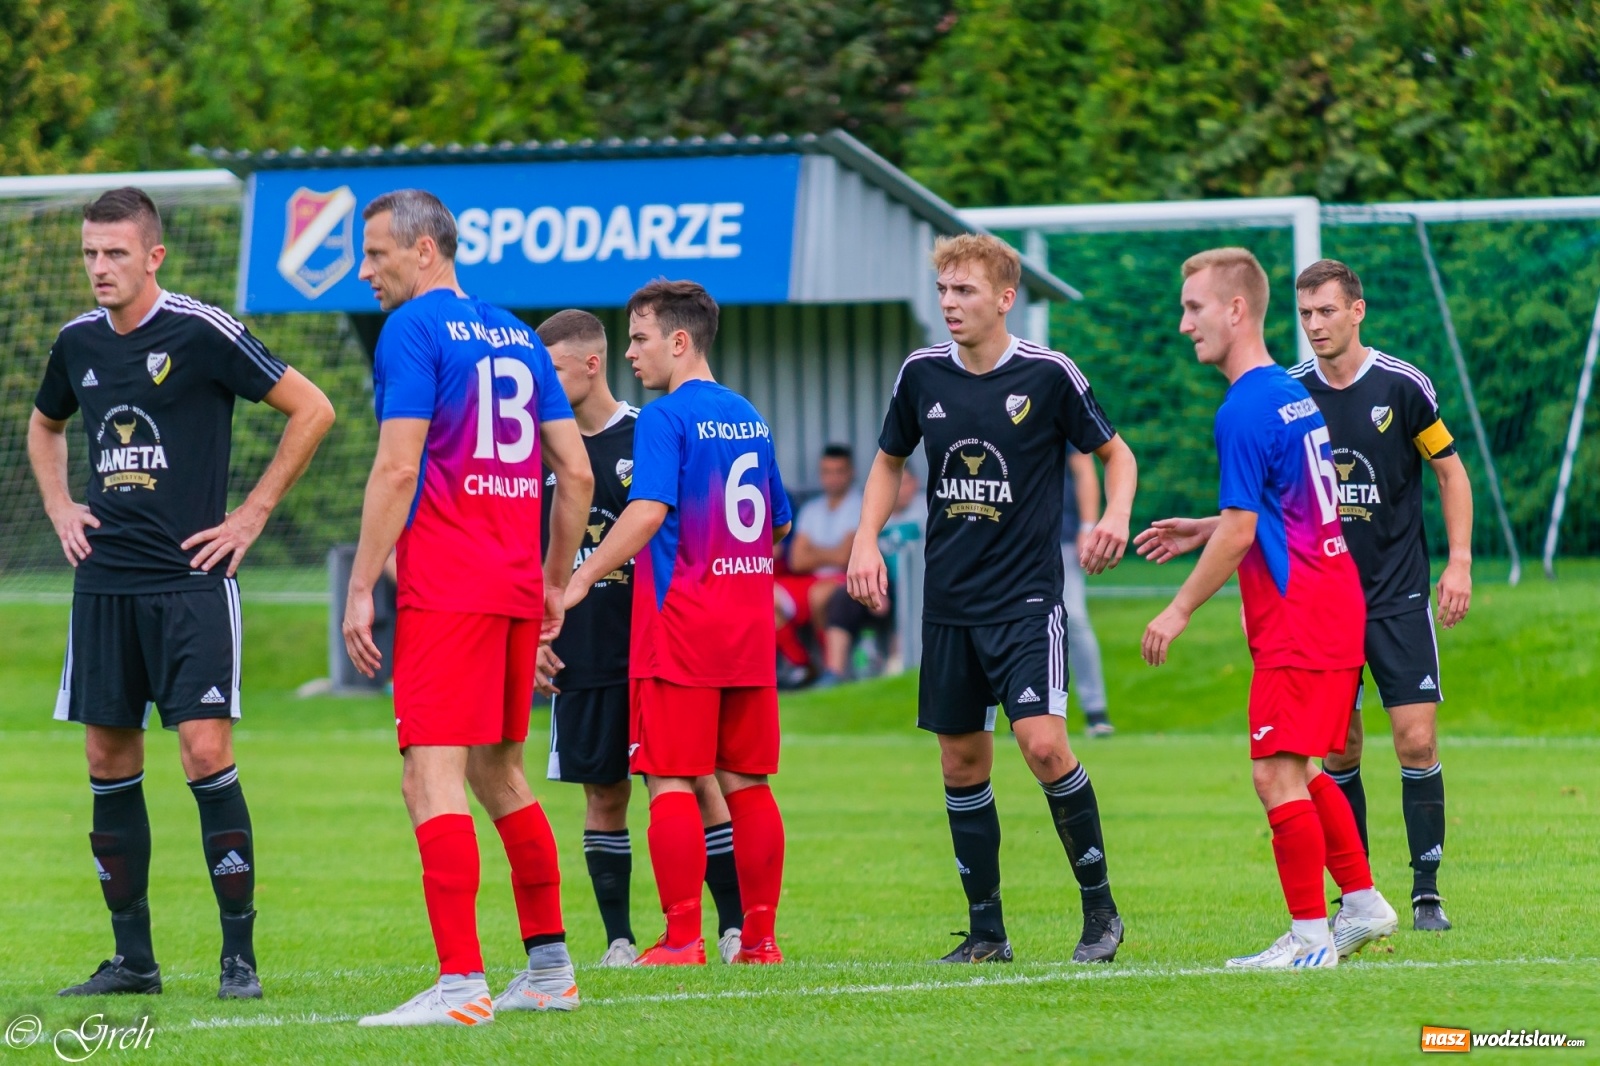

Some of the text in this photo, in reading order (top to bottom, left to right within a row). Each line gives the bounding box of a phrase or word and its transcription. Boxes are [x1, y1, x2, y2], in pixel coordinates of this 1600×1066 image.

[454, 203, 745, 265] SPODARZE
[446, 321, 471, 341] KS
[472, 355, 535, 464] 13
[696, 420, 770, 443] KS KOLEJAR
[96, 445, 168, 473] JANETA
[725, 452, 766, 543] 6
[936, 478, 1013, 503] JANETA
[1337, 484, 1381, 504] NETA
[712, 556, 774, 576] CHAŁUPKI
[213, 862, 250, 876] adidas
[1075, 851, 1104, 867] adidas
